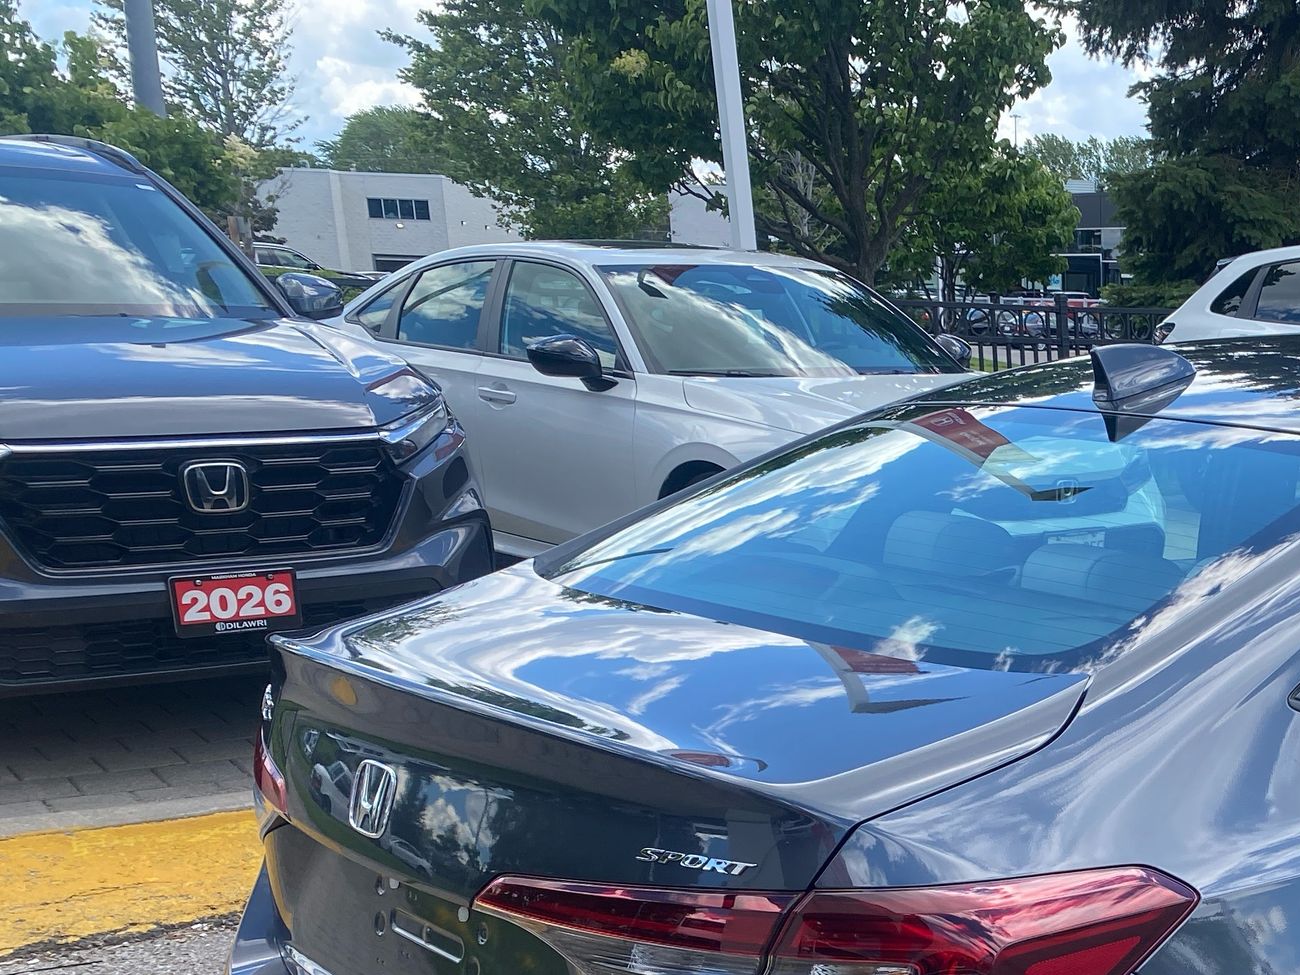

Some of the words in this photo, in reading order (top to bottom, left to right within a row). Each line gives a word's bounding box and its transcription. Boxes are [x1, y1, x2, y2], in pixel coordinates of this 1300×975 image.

[181, 583, 292, 621] 2026
[226, 620, 267, 630] DILAWRI
[635, 847, 757, 875] SPORT
